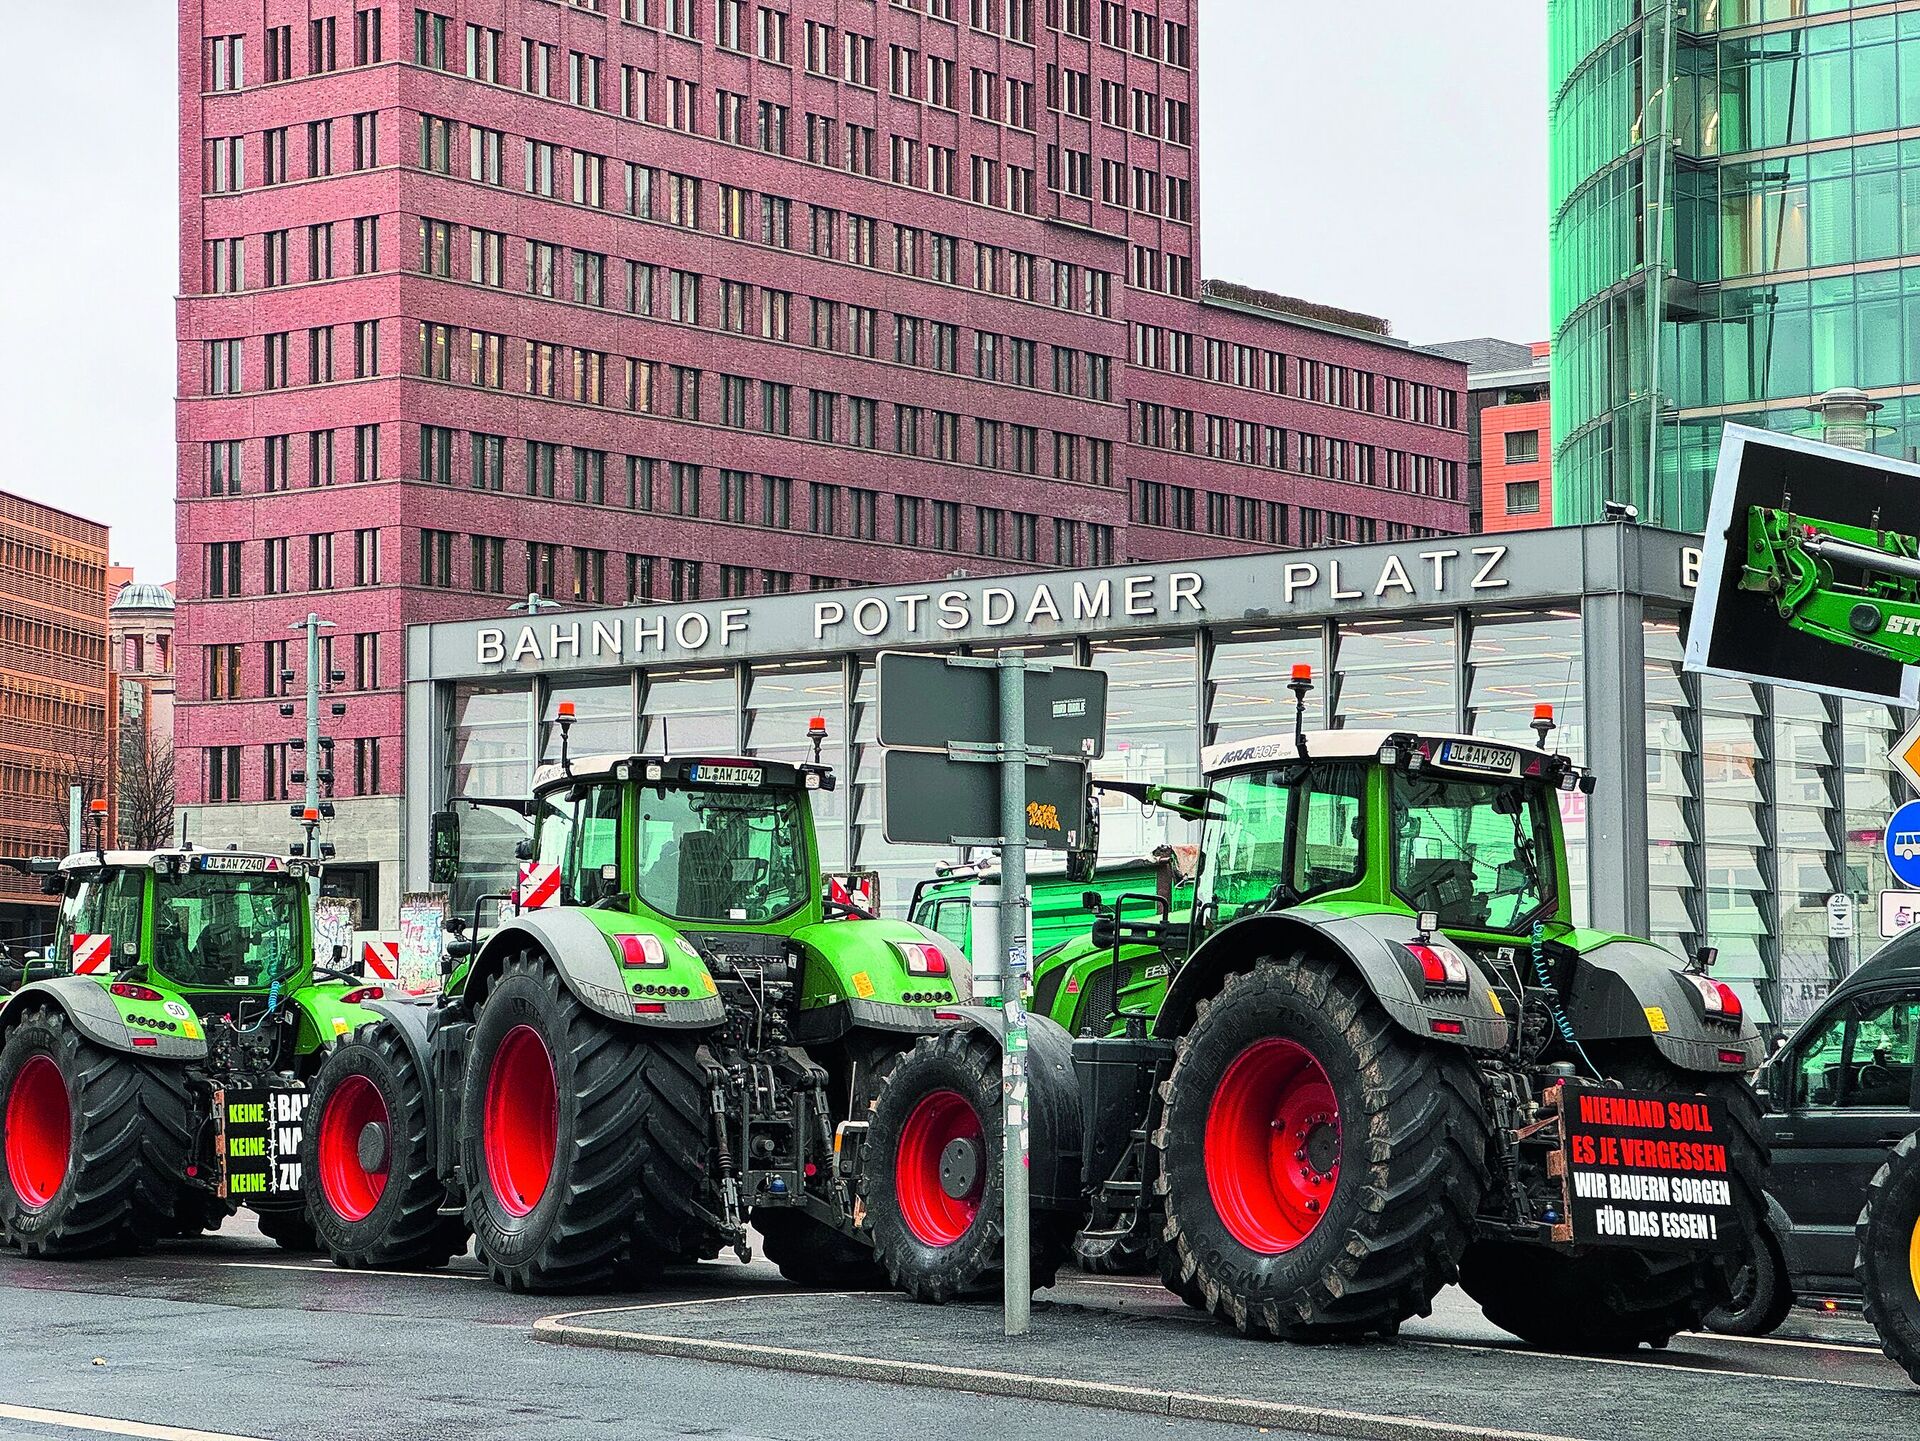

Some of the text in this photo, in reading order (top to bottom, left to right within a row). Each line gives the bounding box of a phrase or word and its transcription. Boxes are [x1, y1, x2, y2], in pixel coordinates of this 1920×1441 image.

[477, 545, 1510, 664] BAHNHOF POTSDAMER PLATZ
[1885, 614, 1920, 637] ST
[1450, 745, 1465, 760] JL
[1472, 748, 1490, 763] AW
[1491, 751, 1512, 767] 936
[698, 767, 760, 782] JL AW 1042
[208, 858, 262, 870] JL AW 7240
[1834, 895, 1844, 903] 27
[168, 1003, 185, 1016] 50
[229, 1104, 264, 1123] KEINE
[1579, 1095, 1713, 1132] NIEMAND SOLL
[229, 1137, 265, 1156] KEINE
[1572, 1135, 1727, 1173] ES JE VERGESSEN
[231, 1173, 266, 1193] KEINE
[1573, 1172, 1731, 1205] WIR BAUERN SORGEN
[1596, 1204, 1626, 1236] FÜR
[1628, 1210, 1660, 1238] DAS
